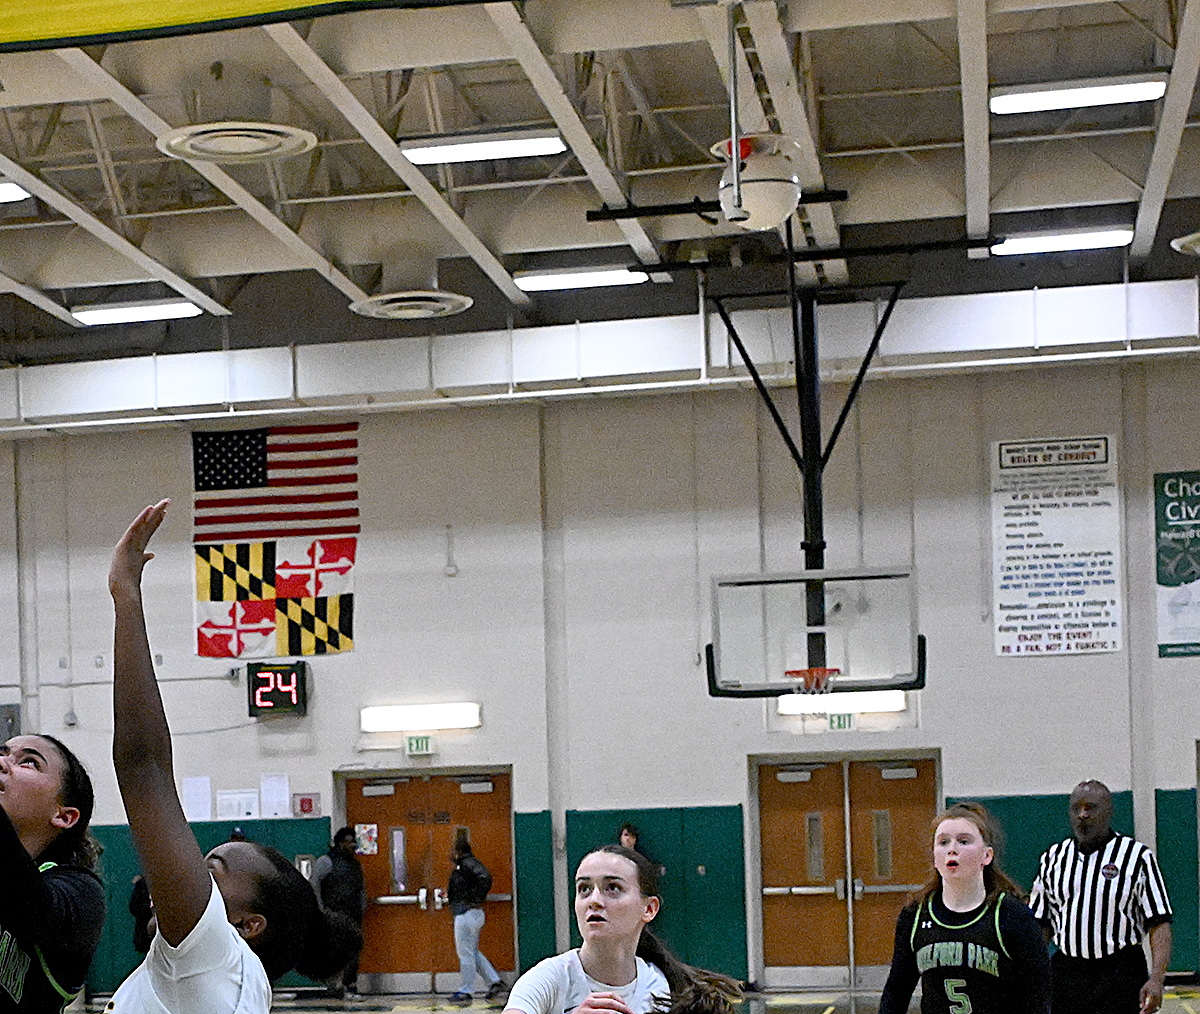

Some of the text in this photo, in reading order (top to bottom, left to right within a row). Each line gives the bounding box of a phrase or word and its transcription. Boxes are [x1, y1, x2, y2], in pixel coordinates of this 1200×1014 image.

[1018, 633, 1042, 642] ENJOY
[1047, 632, 1062, 641] THE
[1065, 631, 1092, 640] EVENT
[255, 672, 297, 707] 24
[830, 714, 851, 729] EXIT
[408, 736, 430, 752] EXIT
